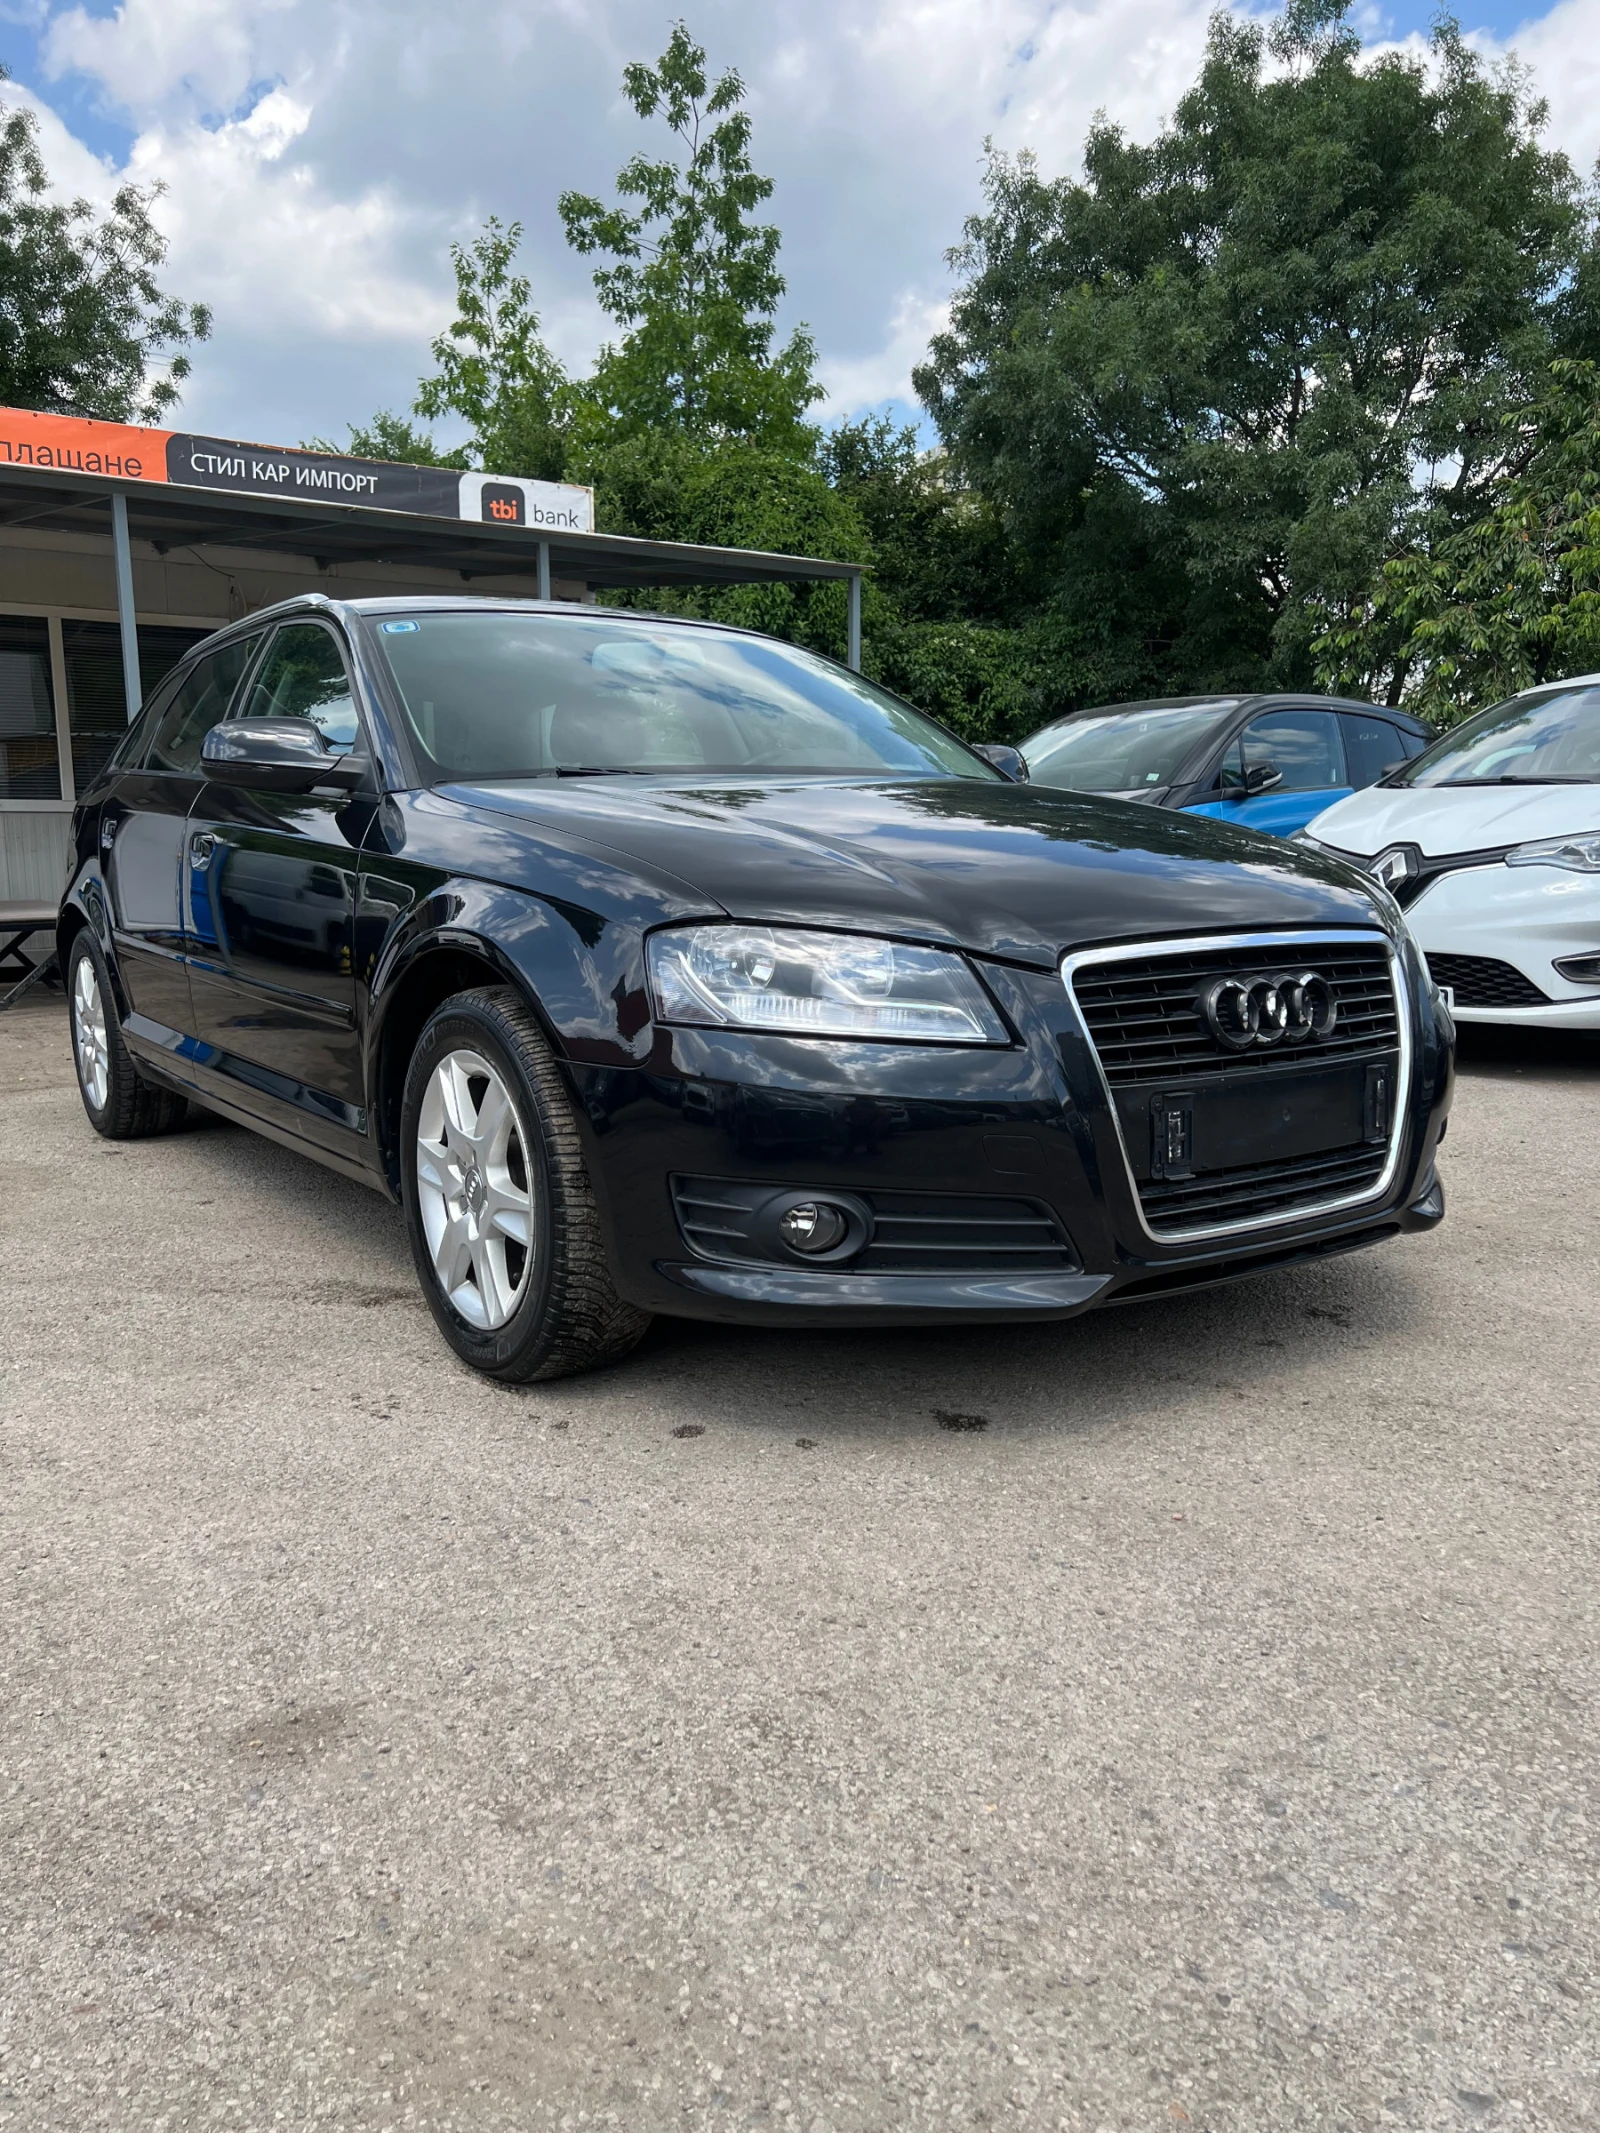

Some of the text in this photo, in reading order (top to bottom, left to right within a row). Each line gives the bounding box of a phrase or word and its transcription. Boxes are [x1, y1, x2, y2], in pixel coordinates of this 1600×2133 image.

[190, 453, 379, 494] СТИЛ КАР ИМПОРТ
[489, 499, 579, 528] tbi bank
